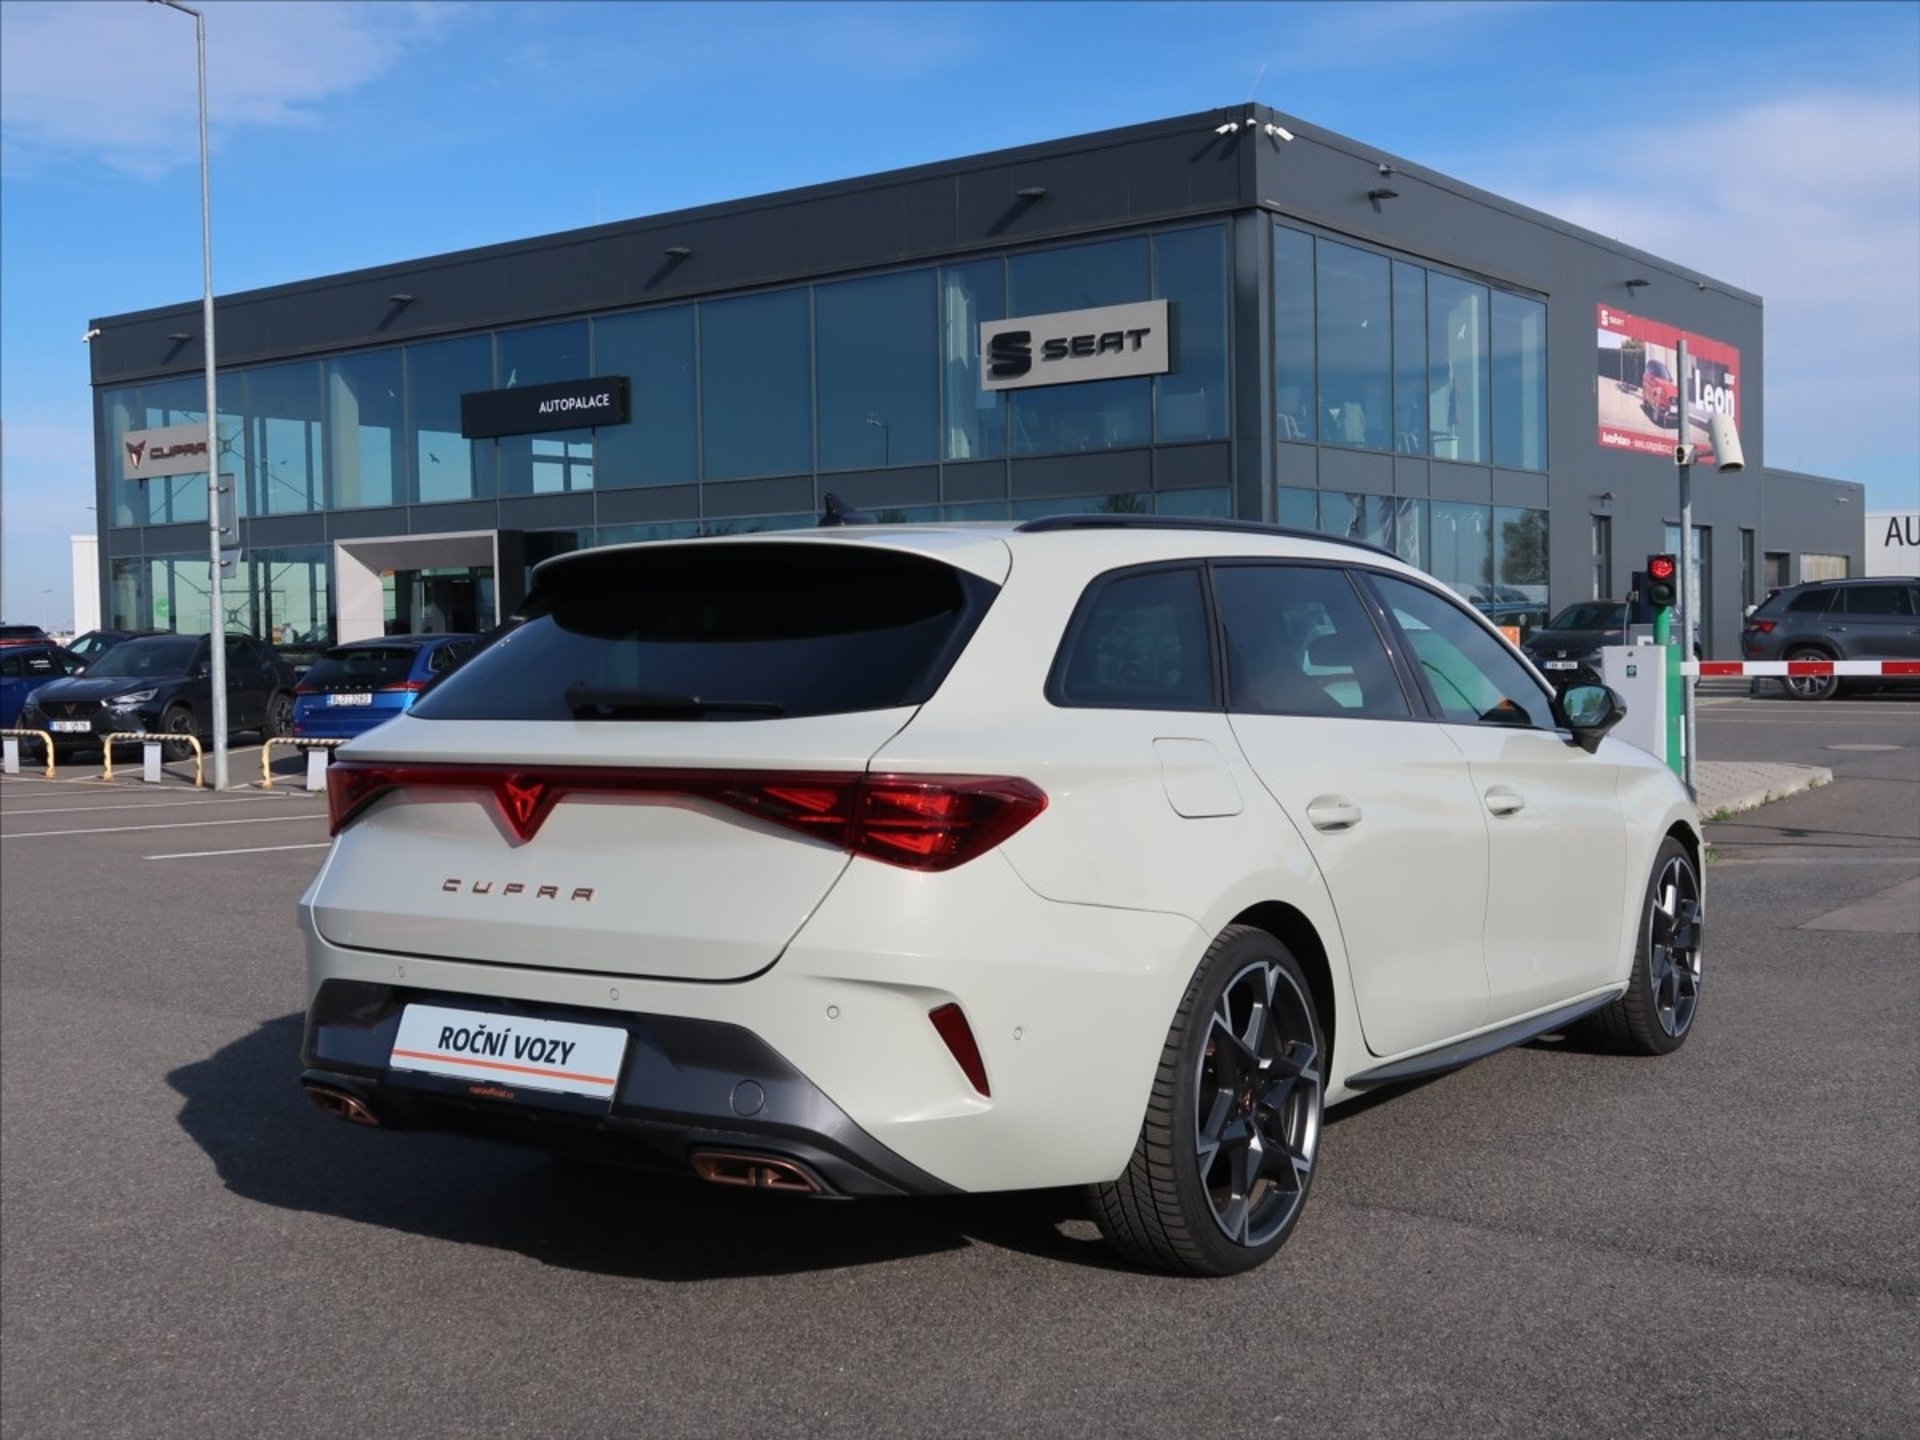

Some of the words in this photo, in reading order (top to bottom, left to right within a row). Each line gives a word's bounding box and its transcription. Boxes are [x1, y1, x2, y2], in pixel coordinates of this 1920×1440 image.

[1042, 328, 1151, 361] SEAT
[539, 393, 611, 413] AUTOPALACE
[1695, 369, 1735, 417] Leon
[150, 442, 208, 460] CUPRA
[1884, 516, 1920, 547] AU
[442, 878, 596, 902] CUPRA
[438, 1024, 511, 1058] ROČNÍ
[514, 1034, 576, 1066] VOZY
